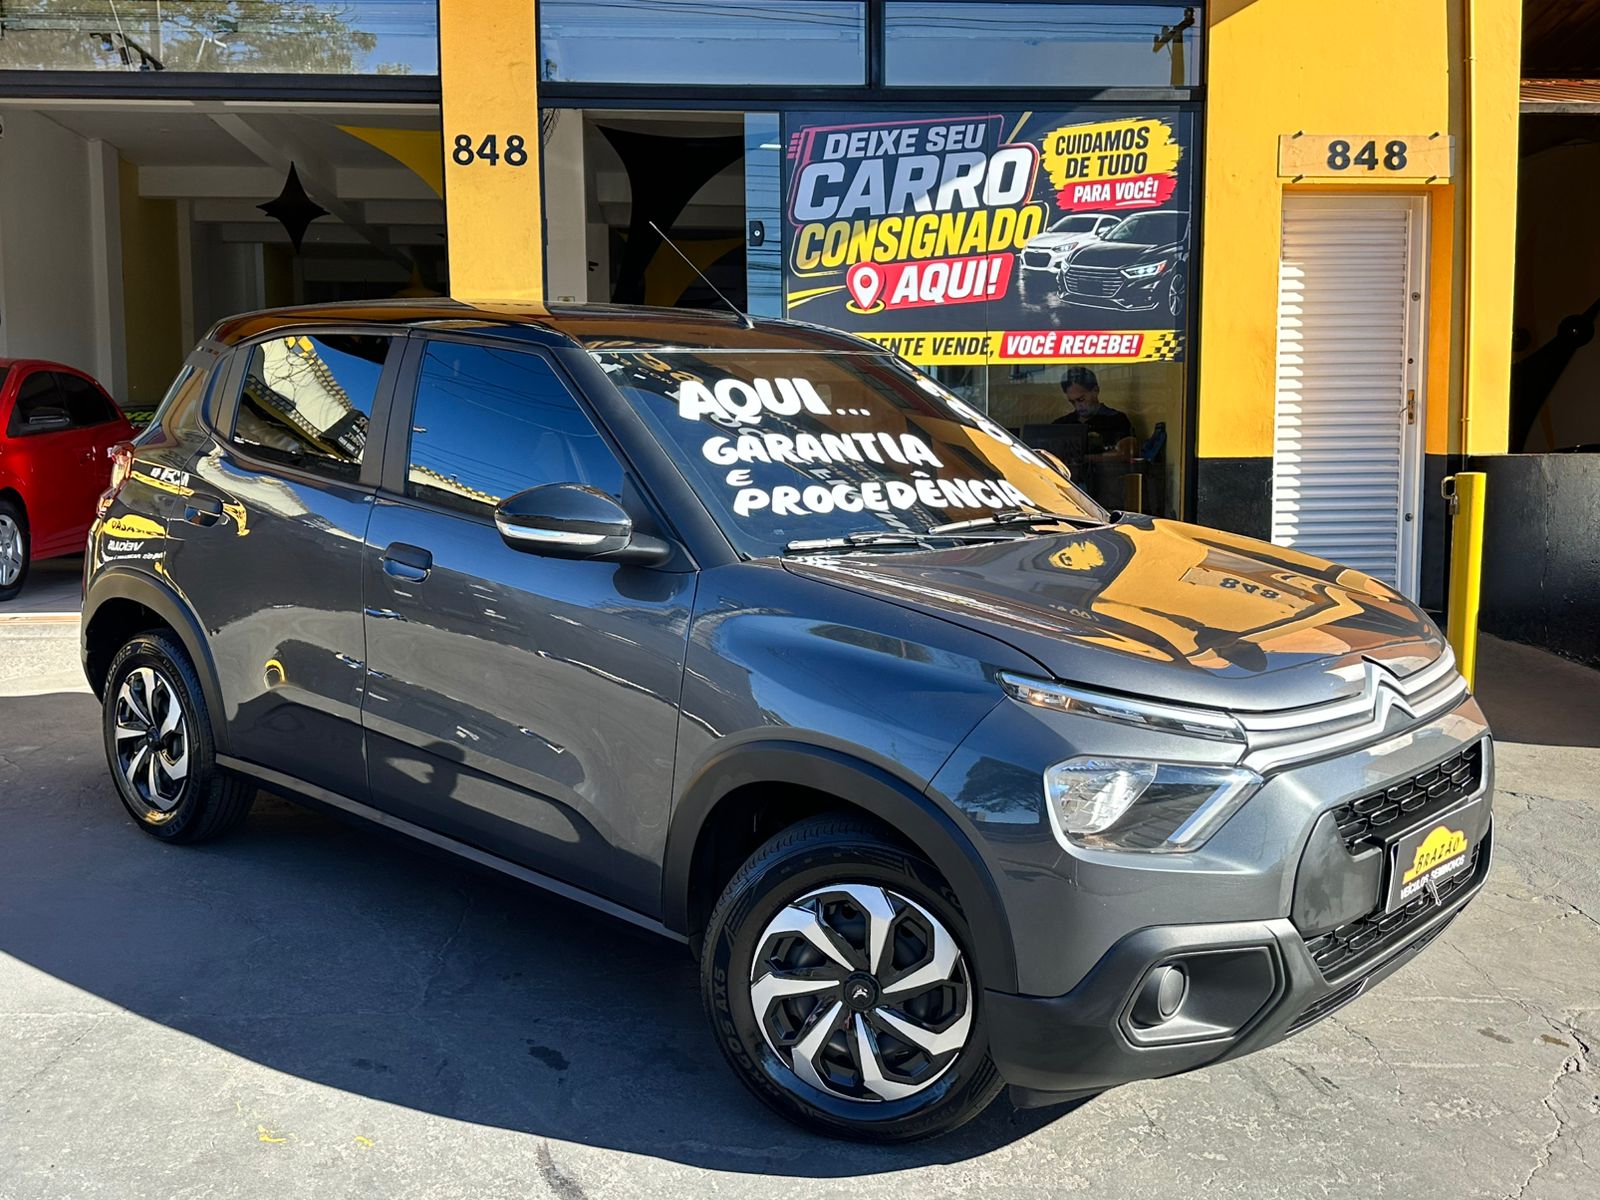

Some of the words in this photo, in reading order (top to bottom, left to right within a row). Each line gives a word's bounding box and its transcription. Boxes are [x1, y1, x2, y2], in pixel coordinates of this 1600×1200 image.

[452, 134, 528, 167] 848
[823, 128, 919, 160] DEIXE
[925, 123, 986, 150] SEU
[1055, 126, 1150, 156] CUIDAMOS
[1326, 140, 1408, 171] 848
[793, 147, 1034, 221] CARRO
[1065, 157, 1090, 179] DE
[1093, 152, 1147, 176] TUDO
[1073, 182, 1112, 203] PARA
[1115, 177, 1158, 201] VOCÊ!
[796, 205, 1042, 270] CONSIGNADO
[890, 258, 1000, 305] AQUI!
[866, 337, 926, 356] ENTE
[932, 336, 994, 358] VENDE,
[1006, 331, 1057, 355] VOCÊ
[1058, 333, 1140, 355] RECEBE!
[678, 377, 871, 426] AQUI...
[701, 432, 945, 469] GARANTIA
[725, 468, 754, 487] E
[733, 470, 1037, 518] PROCEDÊNCIA
[1415, 836, 1461, 874] BRAZÃO
